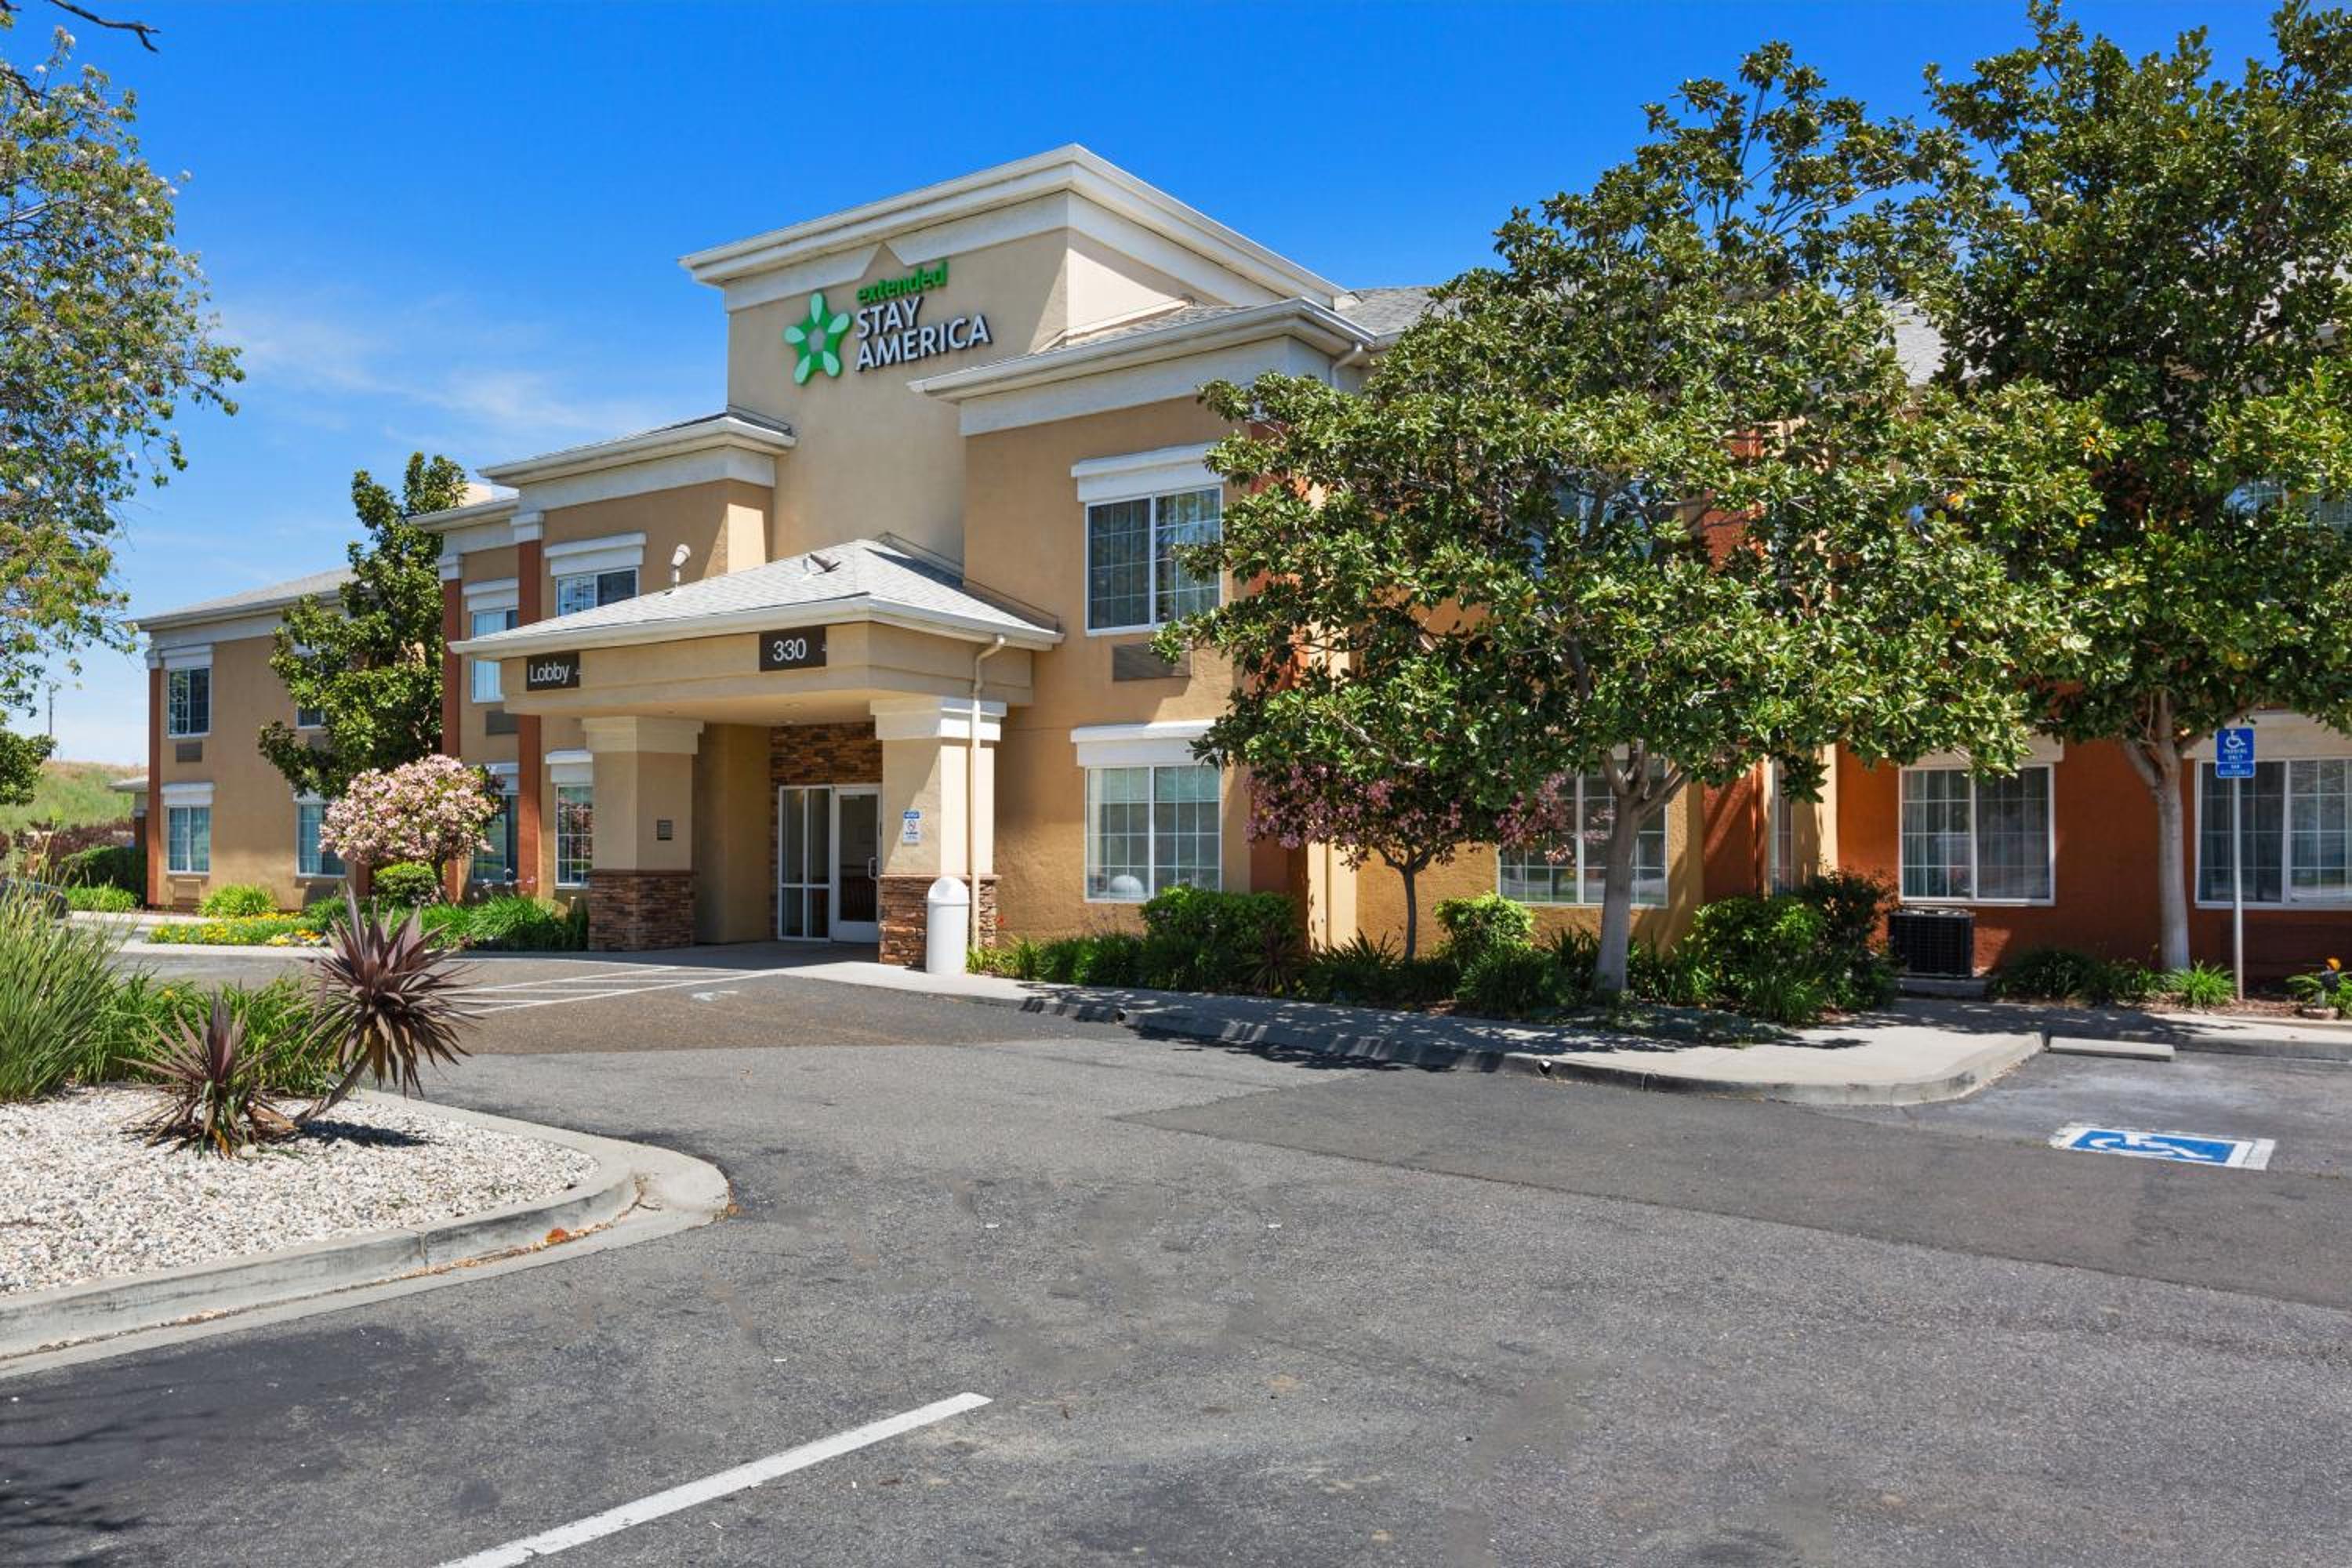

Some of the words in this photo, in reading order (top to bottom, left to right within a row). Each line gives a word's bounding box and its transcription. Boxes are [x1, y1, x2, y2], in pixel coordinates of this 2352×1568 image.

[856, 260, 949, 302] extended
[856, 296, 921, 339] STAY
[855, 314, 991, 372] AMERICA
[772, 637, 807, 661] 330
[529, 662, 570, 684] Lobby
